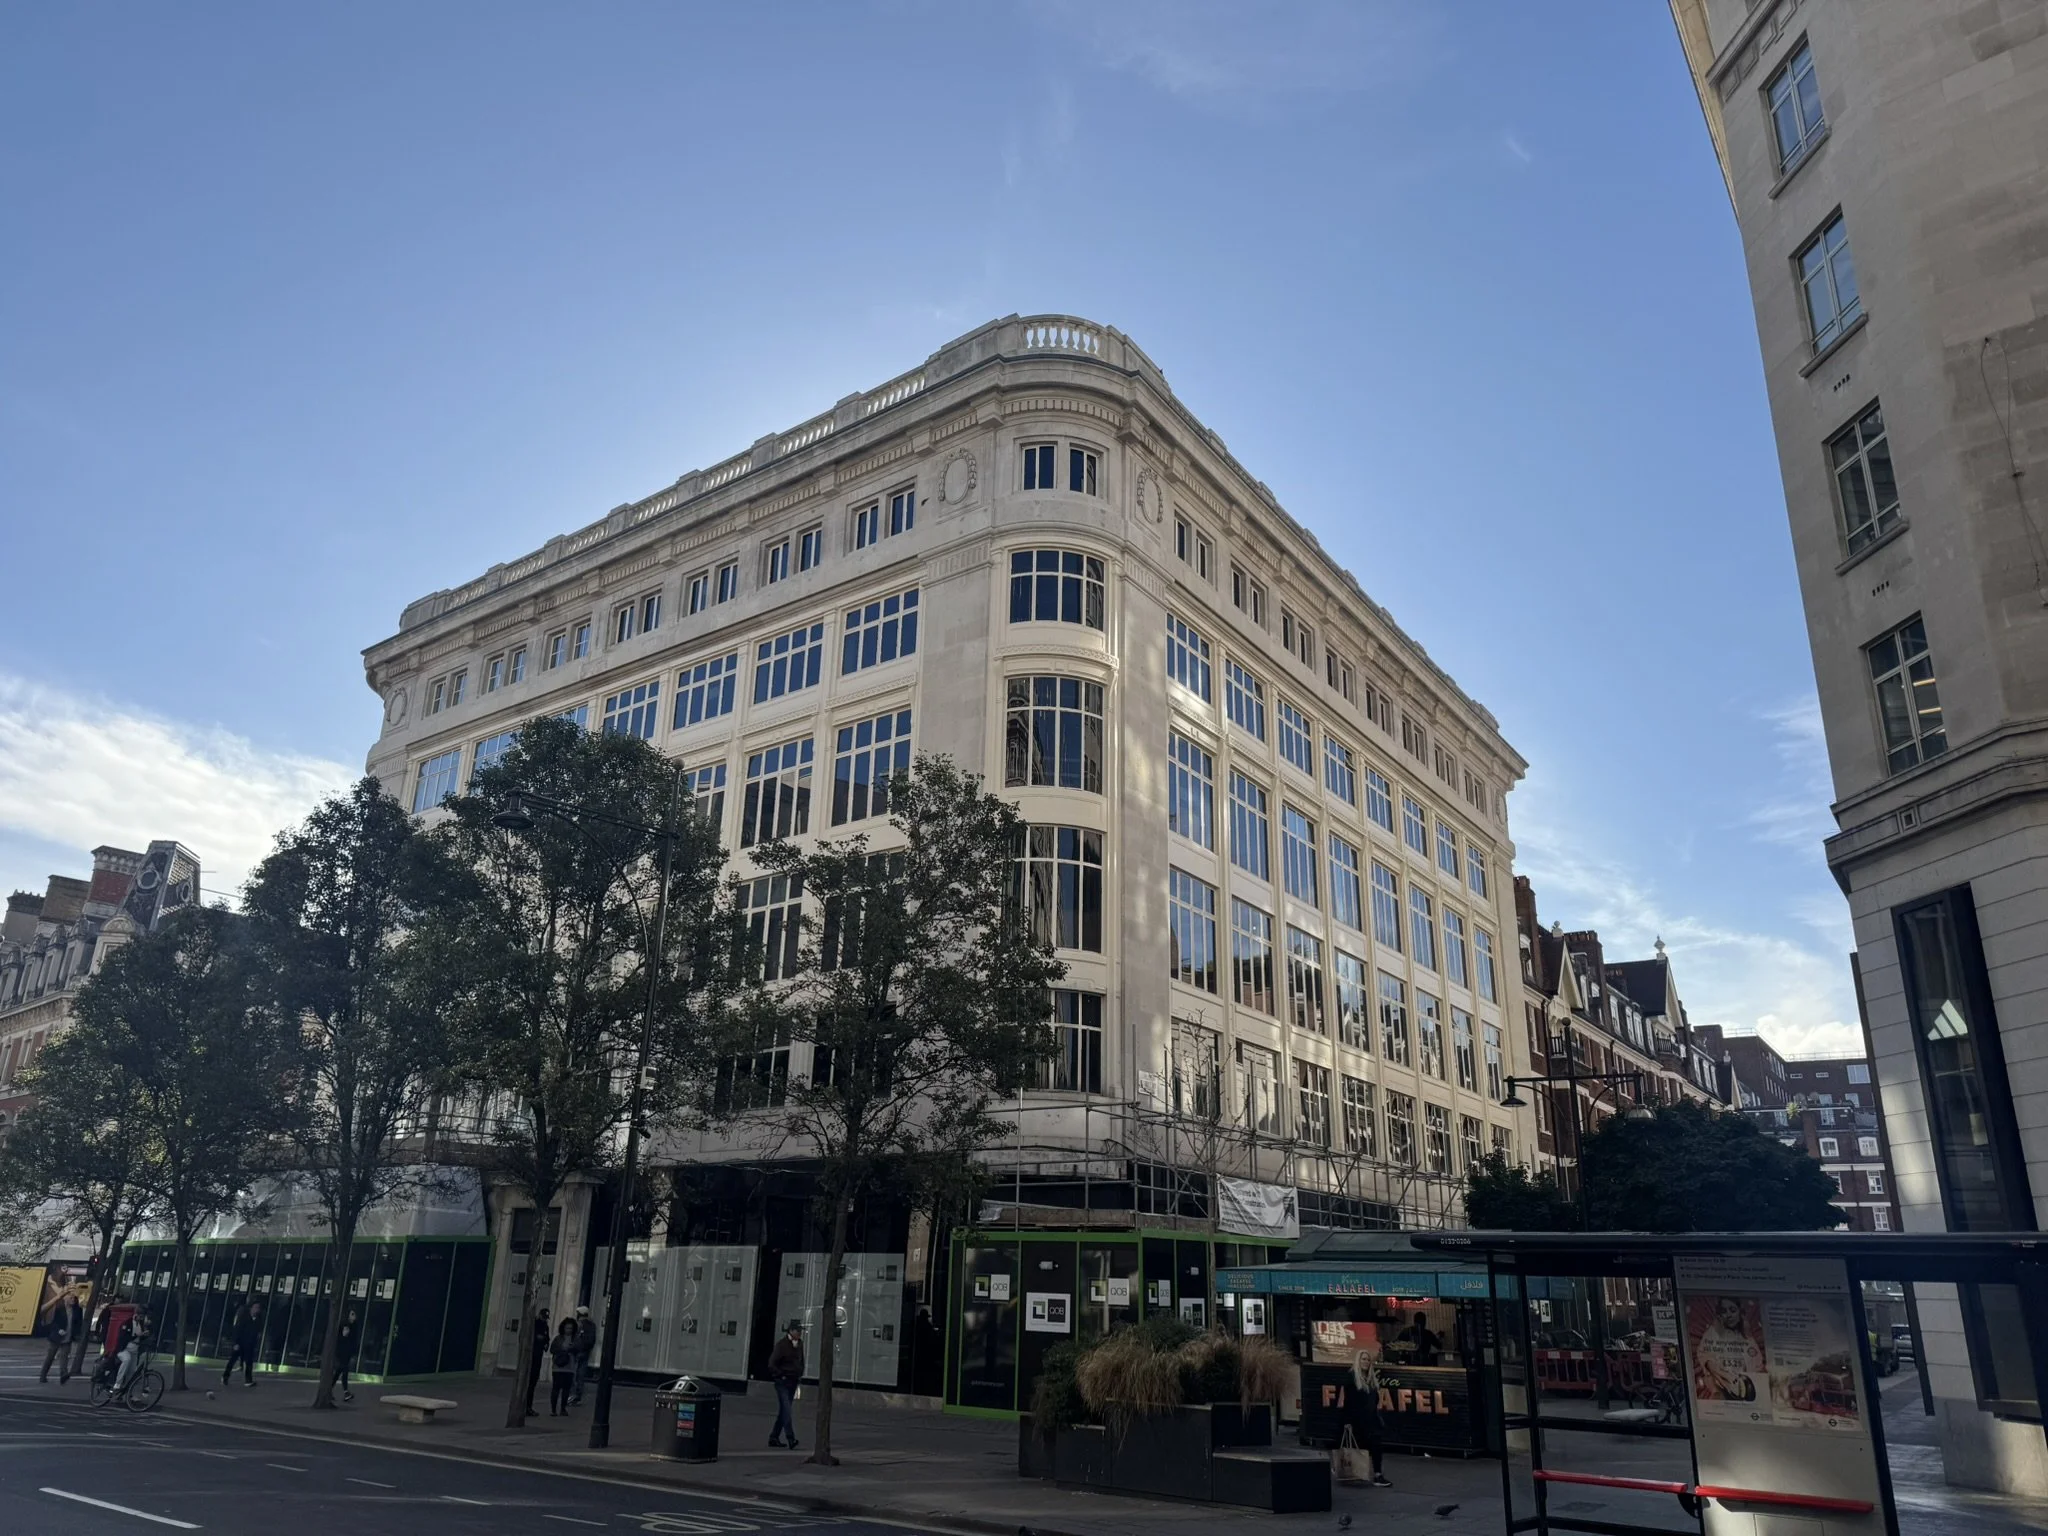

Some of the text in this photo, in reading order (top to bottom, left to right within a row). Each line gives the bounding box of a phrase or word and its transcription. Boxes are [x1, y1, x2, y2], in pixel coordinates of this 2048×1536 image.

[1110, 1286, 1128, 1297] QOB
[1327, 1283, 1376, 1294] FALAFEL
[1048, 1305, 1065, 1316] QOB
[1321, 1385, 1450, 1415] FAFEL
